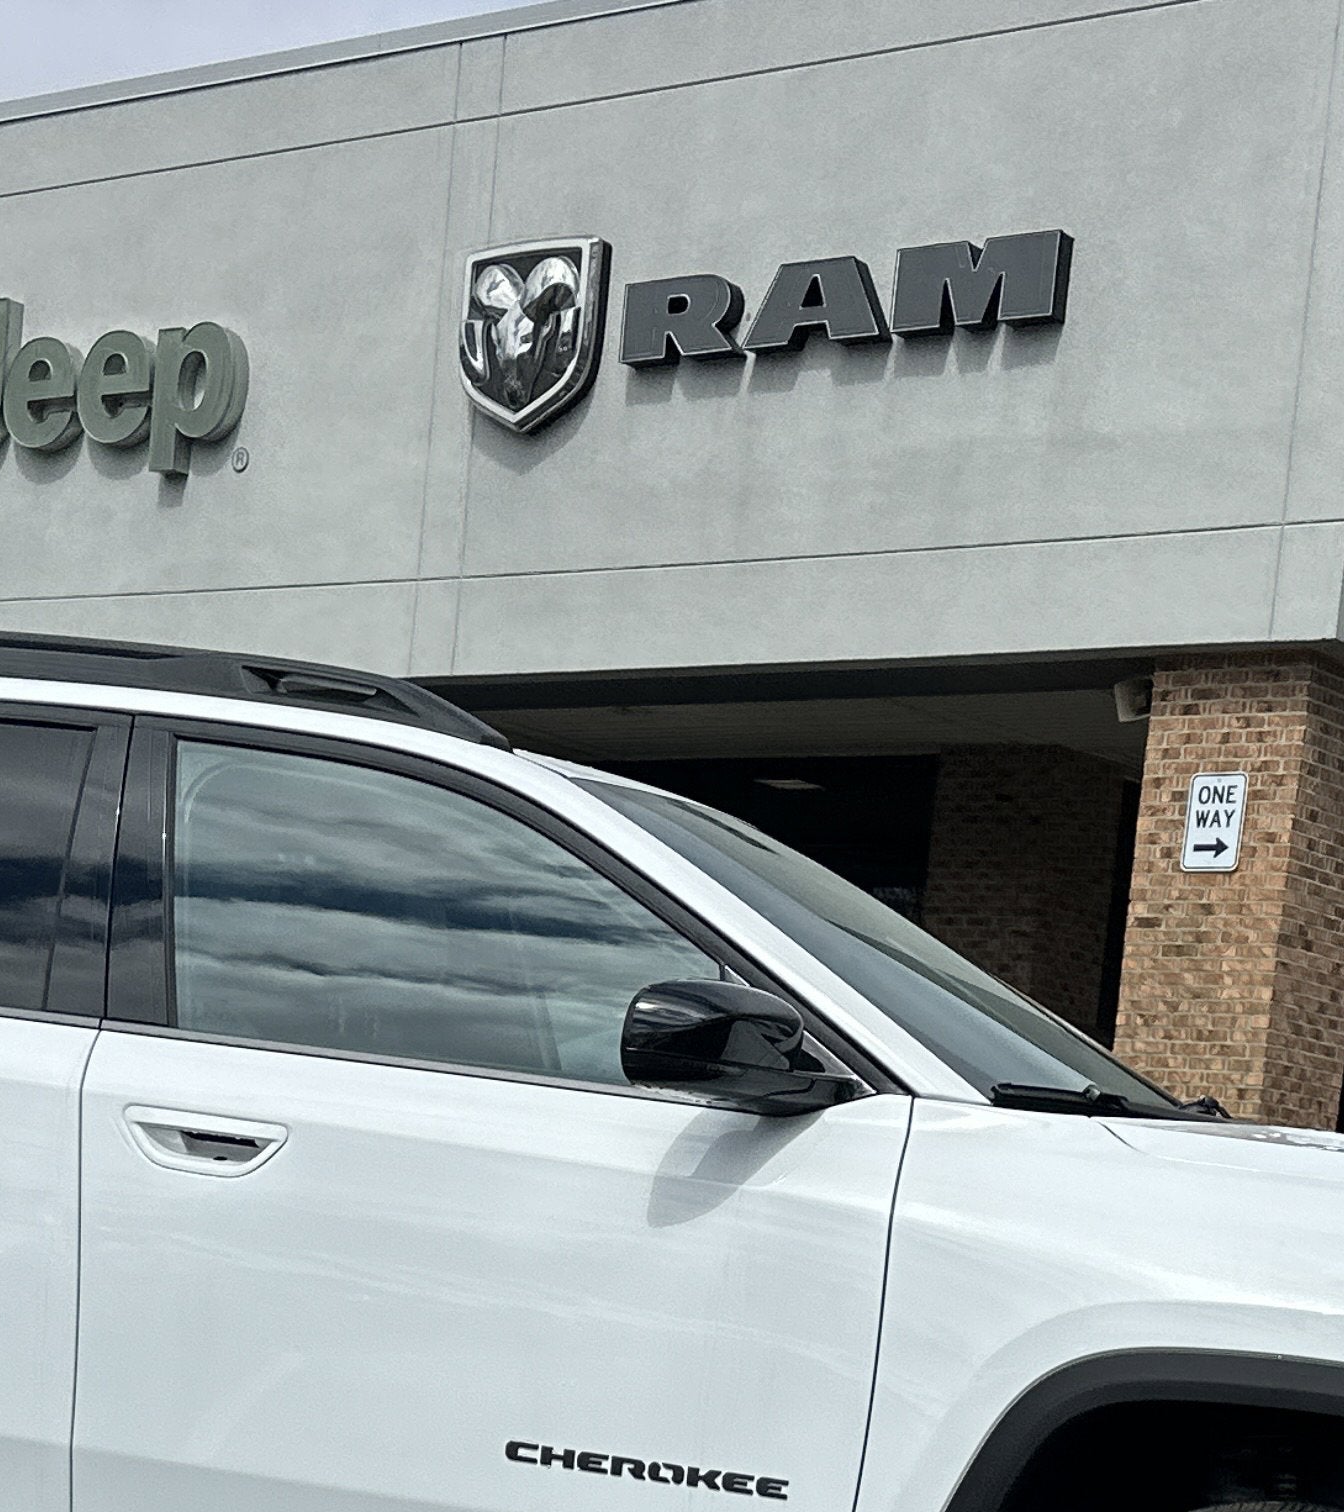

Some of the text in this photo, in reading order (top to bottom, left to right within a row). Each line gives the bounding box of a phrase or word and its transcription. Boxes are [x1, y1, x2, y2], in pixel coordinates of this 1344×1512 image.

[619, 229, 1074, 368] RAM
[1198, 785, 1238, 804] ONE
[1196, 809, 1236, 828] WAY
[505, 1440, 789, 1500] CHEROKEE
